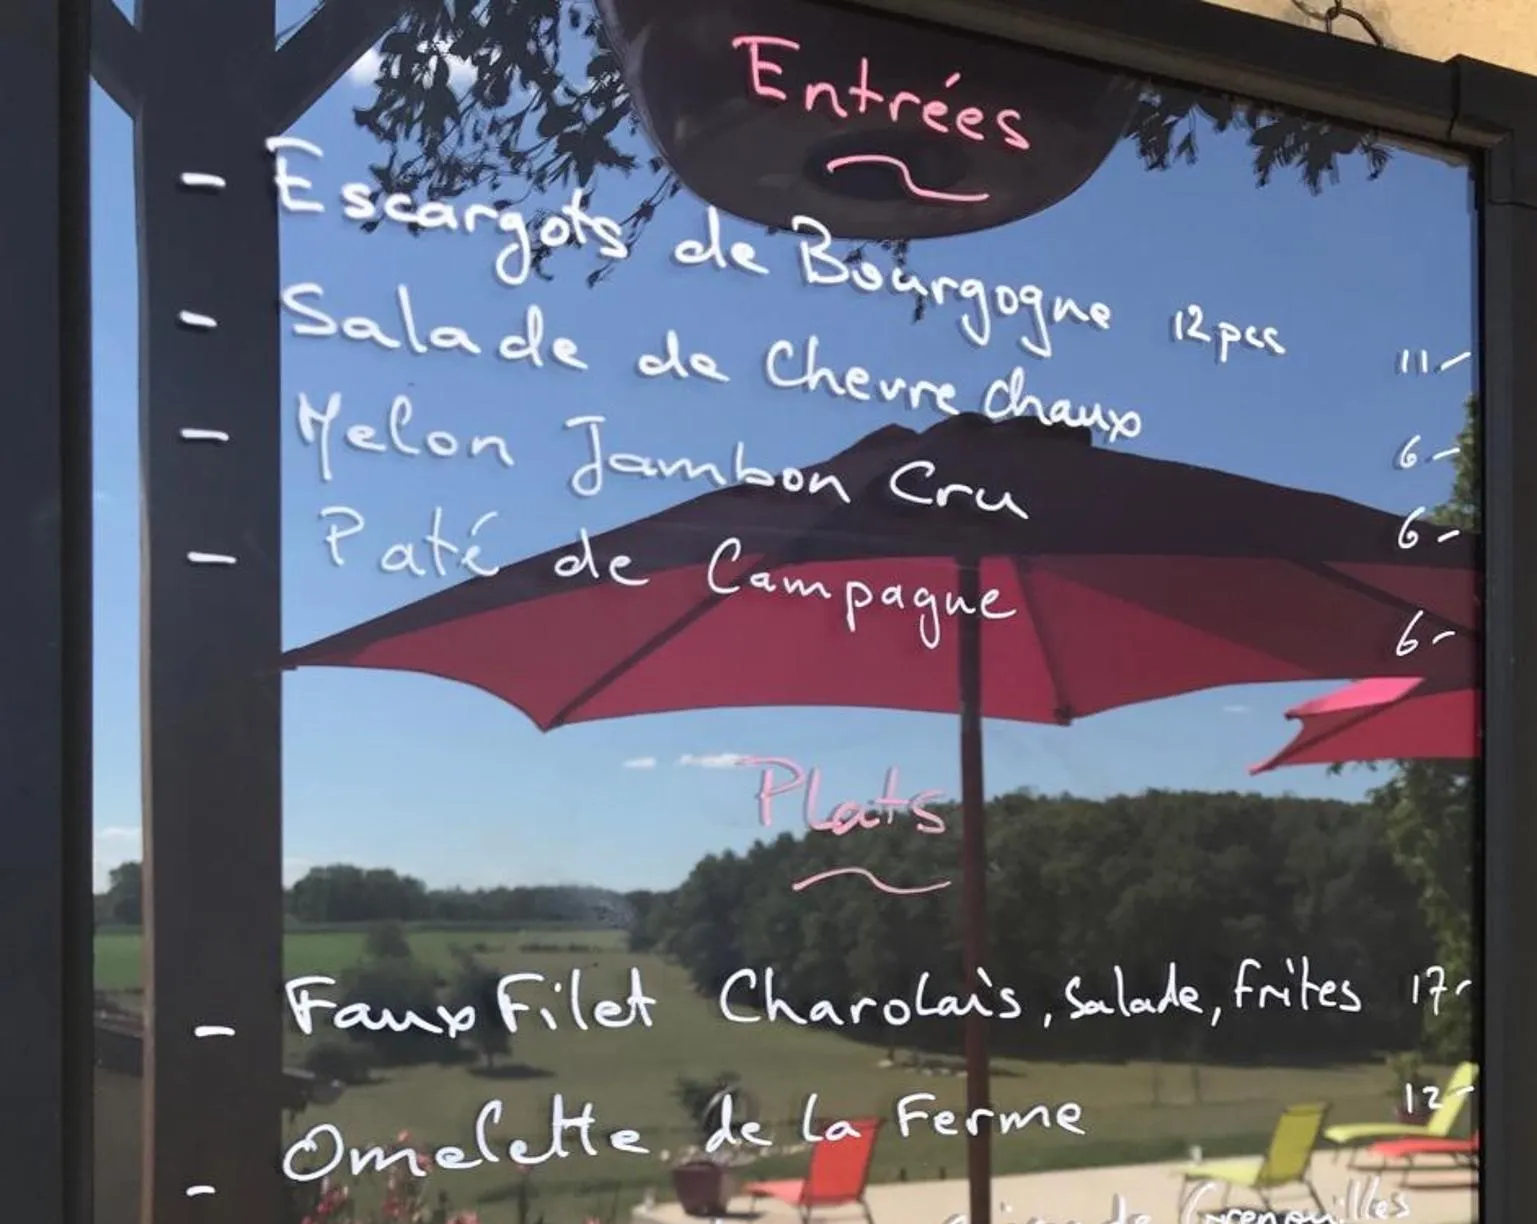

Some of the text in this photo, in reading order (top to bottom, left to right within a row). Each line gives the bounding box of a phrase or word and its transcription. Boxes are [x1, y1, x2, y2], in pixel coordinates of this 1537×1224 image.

[732, 35, 1031, 151] Entrées
[265, 136, 630, 286] Escargots
[674, 205, 770, 276] de
[790, 214, 1113, 359] Bourgogne
[281, 283, 589, 371] Salade
[638, 329, 730, 384] de
[764, 334, 961, 417] Chevre
[298, 392, 1030, 520] Melon Jambon Cru
[554, 527, 652, 587] de
[706, 537, 1019, 650] Campagne
[738, 755, 949, 837] Plats
[285, 975, 476, 1040] Faux
[496, 966, 657, 1030] Filet
[281, 1093, 650, 1183] Omelette
[704, 1093, 773, 1153] de
[896, 1092, 1086, 1138] Ferme
